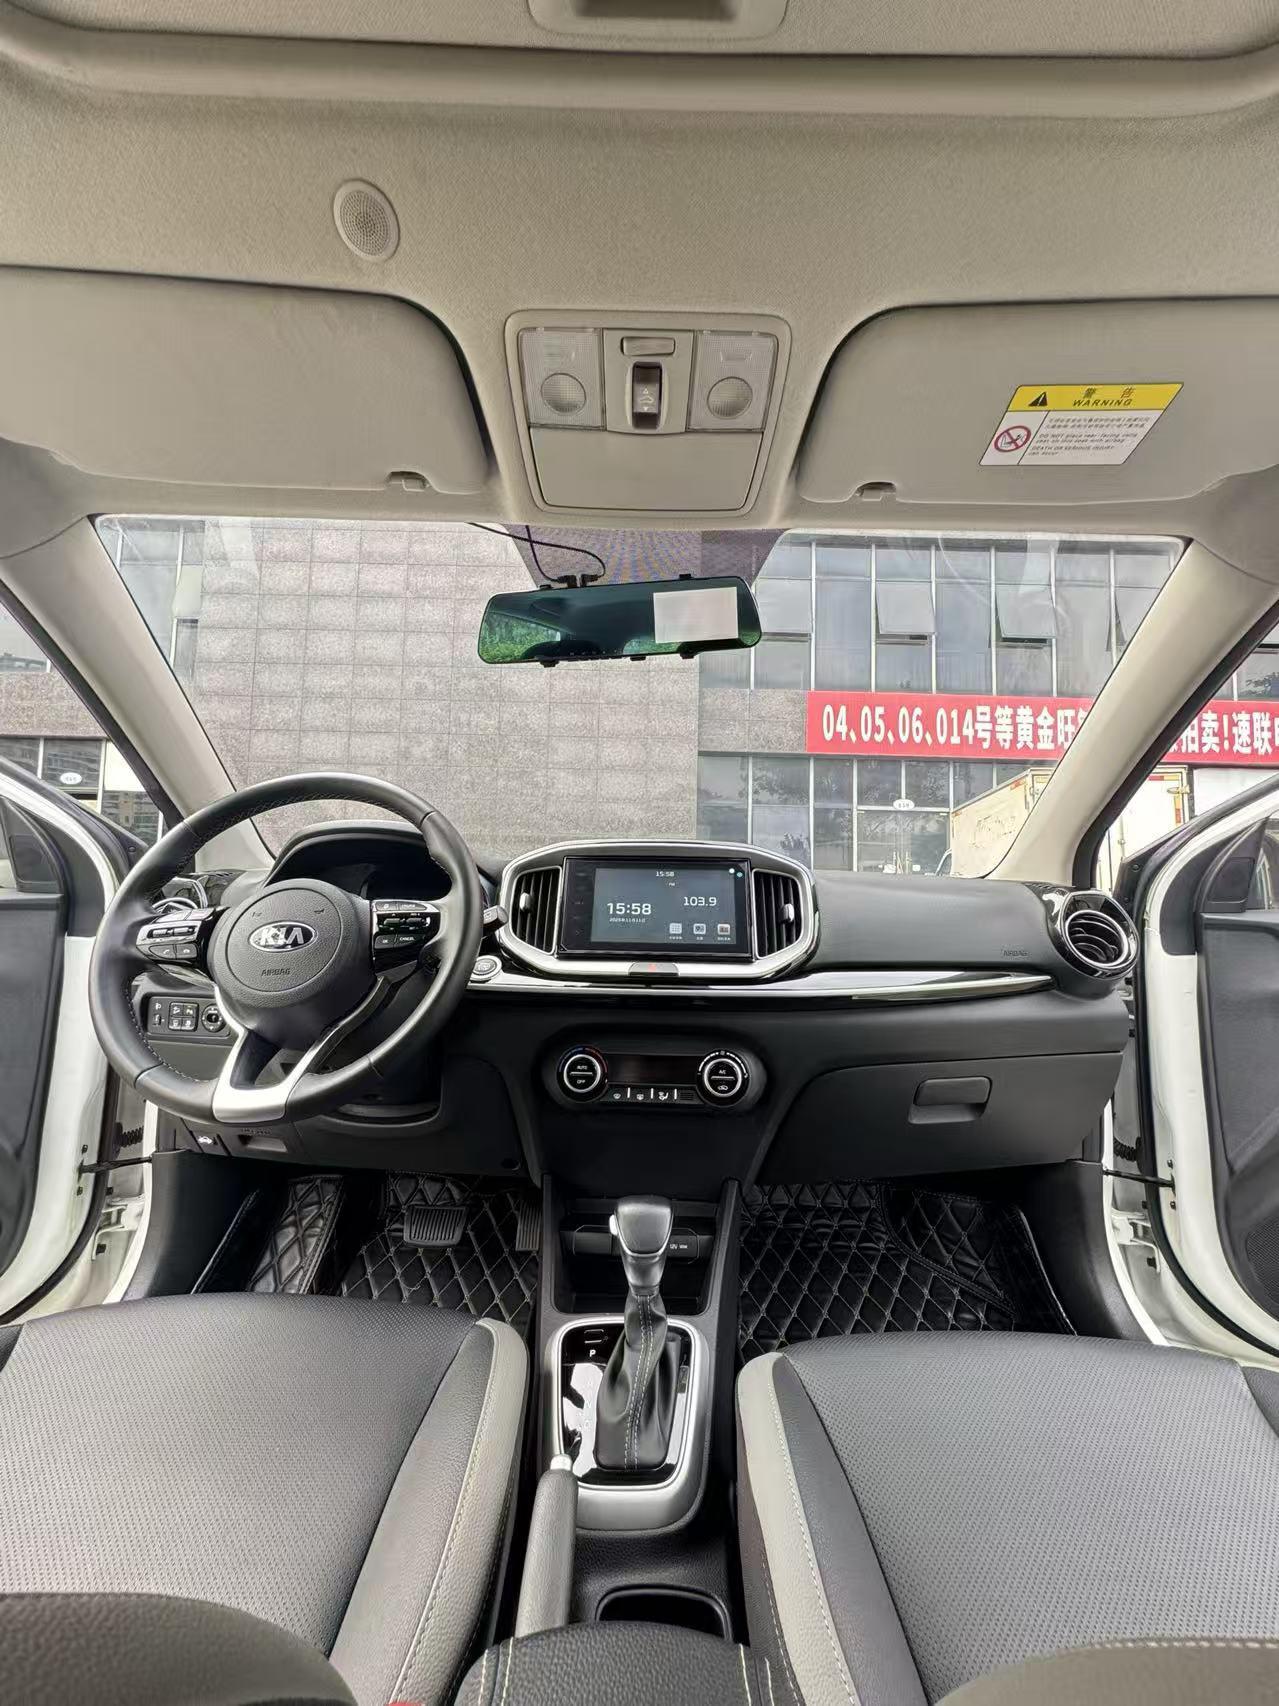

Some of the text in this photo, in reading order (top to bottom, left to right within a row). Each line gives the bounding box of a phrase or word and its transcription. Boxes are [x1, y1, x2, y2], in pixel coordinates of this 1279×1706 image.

[1073, 398, 1133, 406] WARNING
[683, 896, 717, 907] 103.9
[606, 902, 652, 915] 15:58
[261, 968, 291, 976] AIRBAG
[589, 1349, 597, 1357] P
